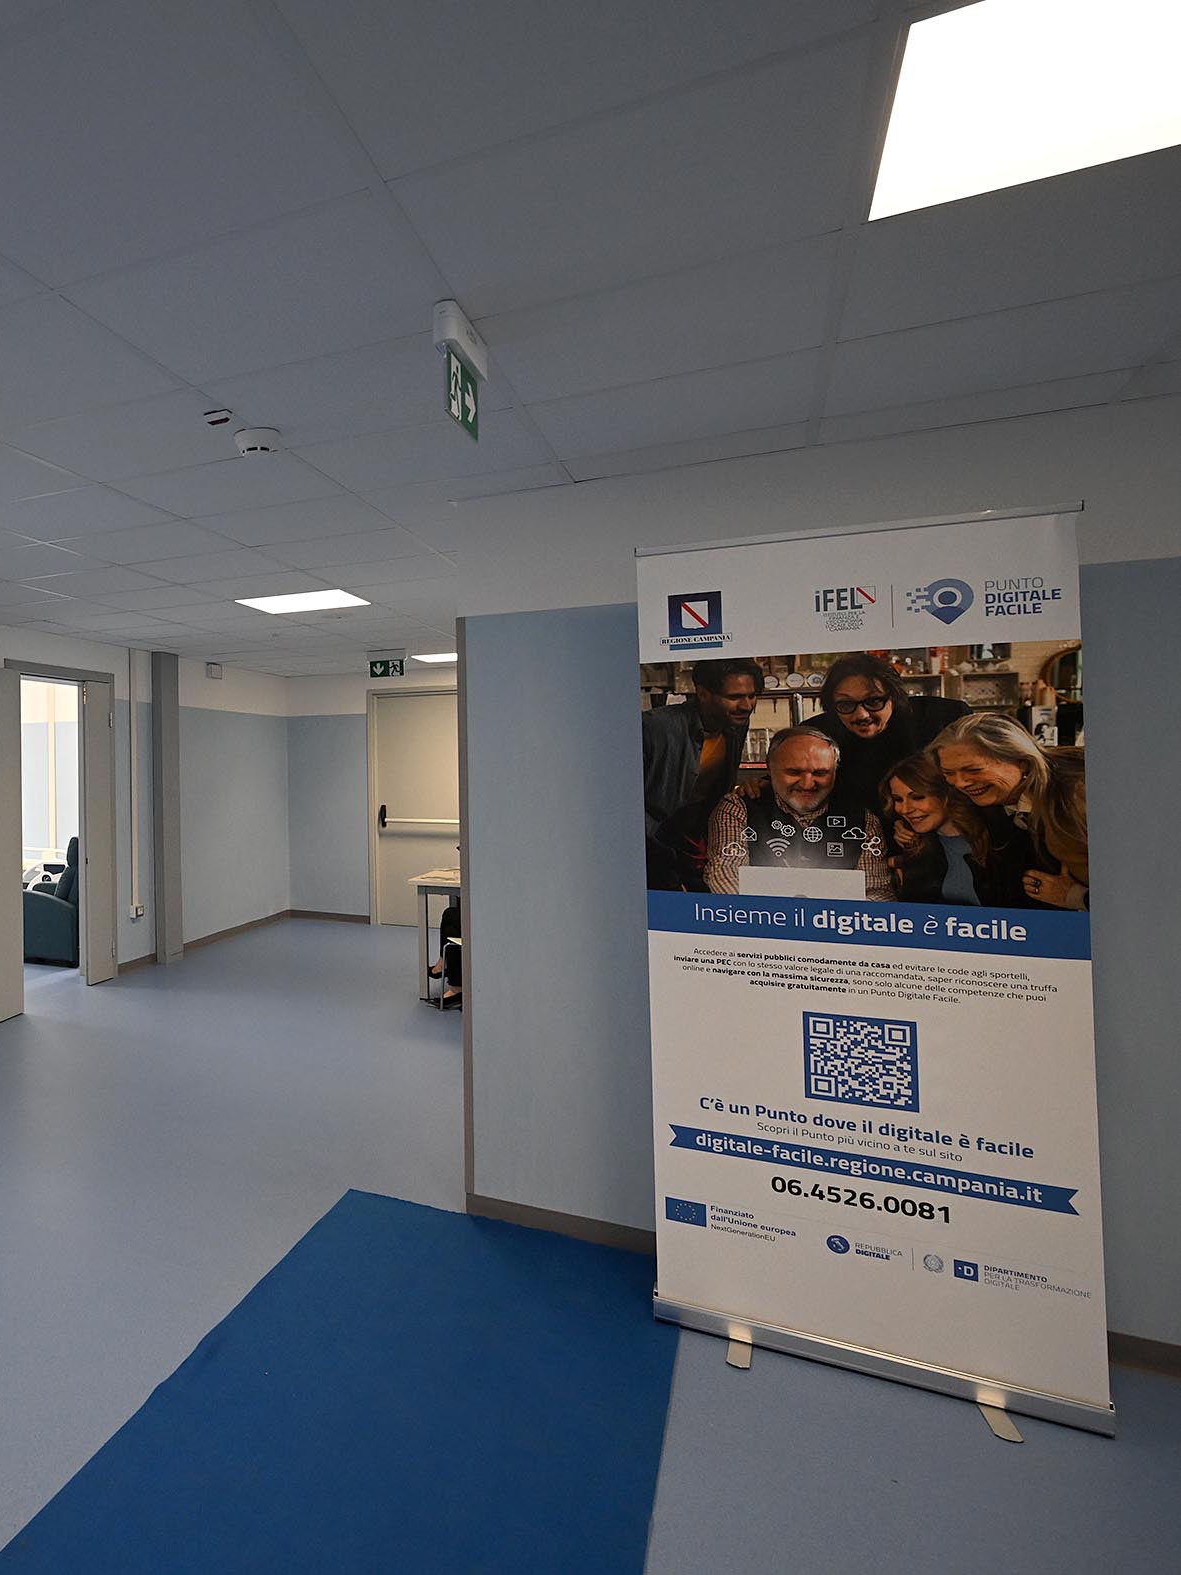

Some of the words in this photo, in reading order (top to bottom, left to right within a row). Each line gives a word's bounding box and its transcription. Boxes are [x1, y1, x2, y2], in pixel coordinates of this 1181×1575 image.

[984, 577, 1044, 592] PUNTO
[985, 588, 1062, 604] DIGITALE
[985, 602, 1043, 617] FACILE
[661, 636, 692, 645] REGIONE
[693, 634, 731, 643] CAMPANIA
[695, 903, 787, 927] Insieme
[794, 908, 805, 928] il
[812, 910, 914, 935] digitale
[923, 914, 938, 935] è
[945, 916, 1028, 942] facile
[673, 955, 699, 963] inviare
[717, 958, 731, 966] PEC
[733, 960, 747, 968] con
[749, 960, 755, 968] lo
[757, 962, 782, 970] stesso
[784, 963, 809, 972] valore
[810, 965, 834, 975] legale
[836, 966, 844, 975] di
[845, 968, 861, 976] una
[863, 970, 925, 982] raccomandata,
[927, 974, 952, 984] saper
[955, 978, 1008, 988] riconoscere
[1010, 982, 1028, 990] una
[1030, 983, 1058, 993] truffa
[693, 948, 727, 958] Accedere
[737, 952, 763, 960] servizi
[764, 953, 796, 962] pubblici
[797, 956, 857, 967] comodamente
[858, 960, 869, 968] da
[893, 962, 903, 970] ed
[905, 964, 936, 974] evitare
[937, 966, 945, 974] le
[947, 966, 969, 976] code
[971, 970, 987, 980] agli
[989, 970, 1030, 982] sportelli,
[683, 964, 705, 972] online
[713, 967, 745, 976] navigare
[763, 970, 770, 978] la
[771, 972, 808, 981] massima
[809, 974, 851, 986] sicurezza,
[853, 978, 873, 986] sono
[875, 980, 893, 988] solo
[894, 982, 923, 990] alcune
[925, 984, 946, 992] delle
[947, 986, 1005, 999] competenze
[1007, 990, 1023, 1000] che
[1025, 993, 1047, 1002] puoi
[749, 979, 785, 988] acquisire
[787, 982, 847, 994] gratuitamente
[849, 986, 856, 994] in
[871, 989, 896, 998] Punto
[897, 990, 931, 1000] Digitale
[933, 994, 961, 1004] Facile.
[699, 1096, 724, 1112] C'è
[729, 1104, 750, 1116] un
[755, 1104, 808, 1124] Punto
[813, 1114, 857, 1131] dove
[862, 1120, 873, 1134] il
[879, 1123, 953, 1146] digitale
[959, 1134, 970, 1148] è
[976, 1136, 1034, 1158] facile
[757, 1122, 790, 1136] Scopri
[793, 1127, 799, 1137] il
[801, 1128, 835, 1142] Punto
[837, 1135, 854, 1146] più
[857, 1138, 891, 1151] vicino
[893, 1144, 901, 1152] a
[903, 1144, 915, 1154] te
[919, 1146, 937, 1158] sul
[939, 1150, 963, 1162] sito
[695, 1132, 1043, 1203] digitale-facile.regione.campania.it
[771, 1176, 950, 1224] 06.4526.0081
[710, 1205, 755, 1220] Finanziato
[710, 1214, 759, 1230] dall'Unione
[760, 1224, 797, 1238] europea
[711, 1224, 776, 1242] NextGenerationEU
[855, 1242, 903, 1256] REPUBBLICA
[855, 1248, 891, 1260] DIGITALE
[983, 1265, 1048, 1283] DIPARTIMENTO
[984, 1272, 1000, 1280] PER
[1013, 1277, 1092, 1299] TRASFORMAZIONE
[984, 1279, 1020, 1292] DIGITALE
